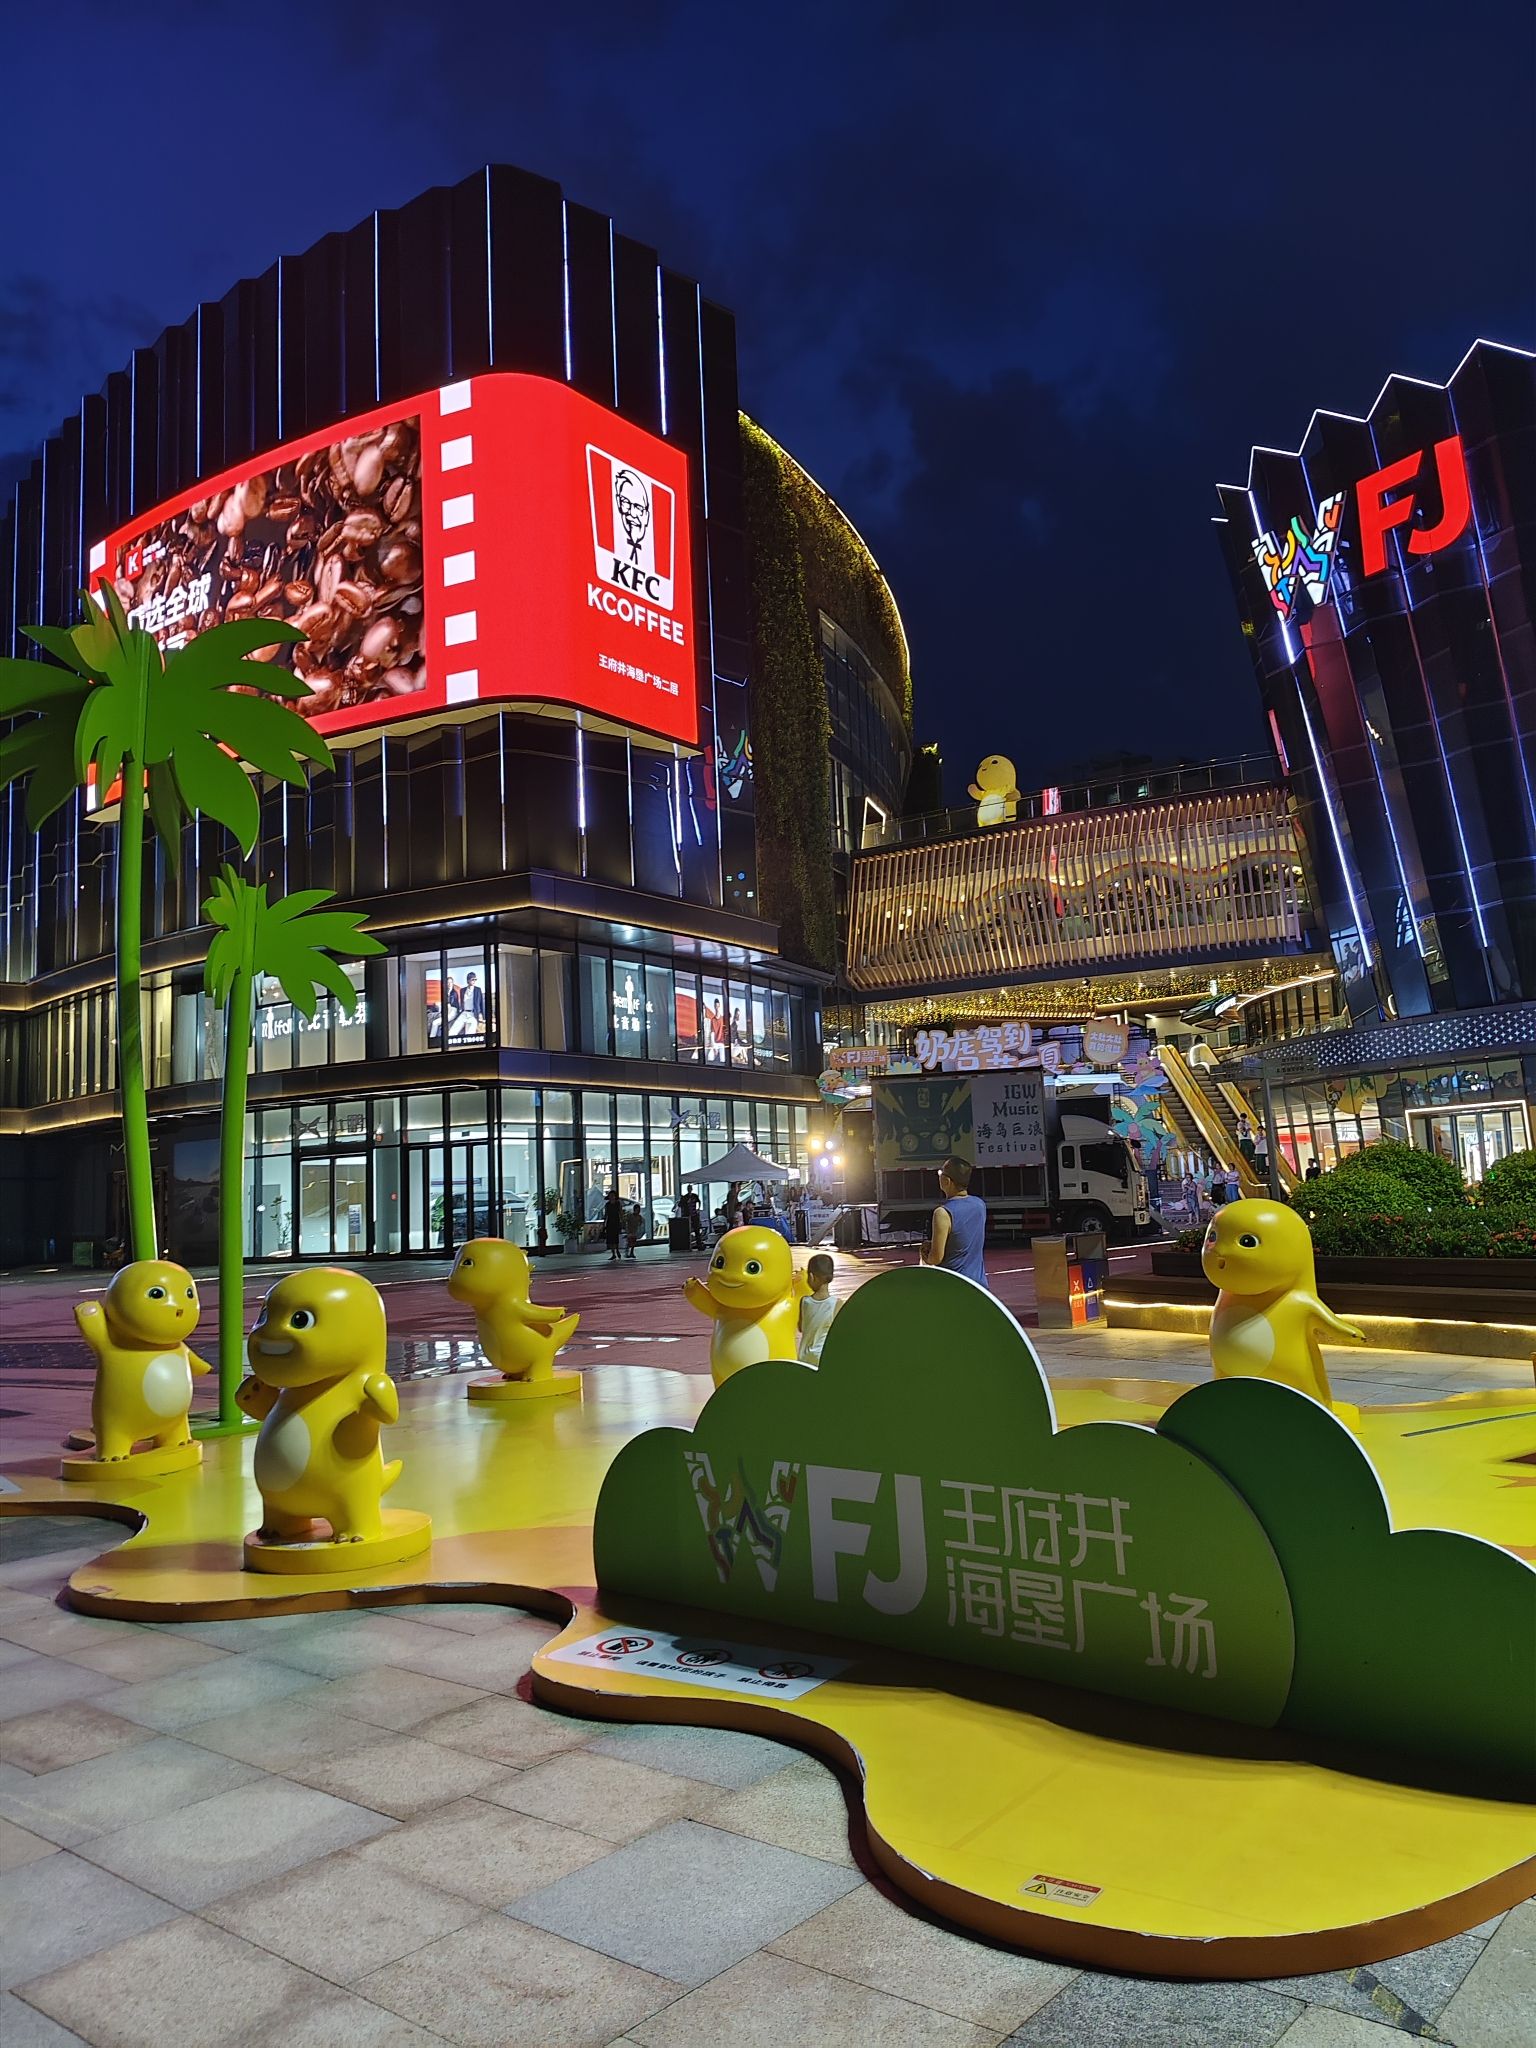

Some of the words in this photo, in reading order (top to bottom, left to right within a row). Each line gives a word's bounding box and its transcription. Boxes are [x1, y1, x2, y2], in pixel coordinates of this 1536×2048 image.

[611, 557, 660, 602] KFC
[587, 582, 685, 646] KCOFFEE
[598, 653, 679, 696] 王府井海垦广场二层
[914, 1021, 1032, 1070] 奶龙驾到
[992, 1101, 1039, 1118] Music
[1003, 1083, 1037, 1100] IGW
[976, 1140, 1043, 1155] Festival
[683, 1450, 928, 1616] WFJ
[939, 1478, 1134, 1576] 王府井
[944, 1554, 1219, 1679] 海垦广场
